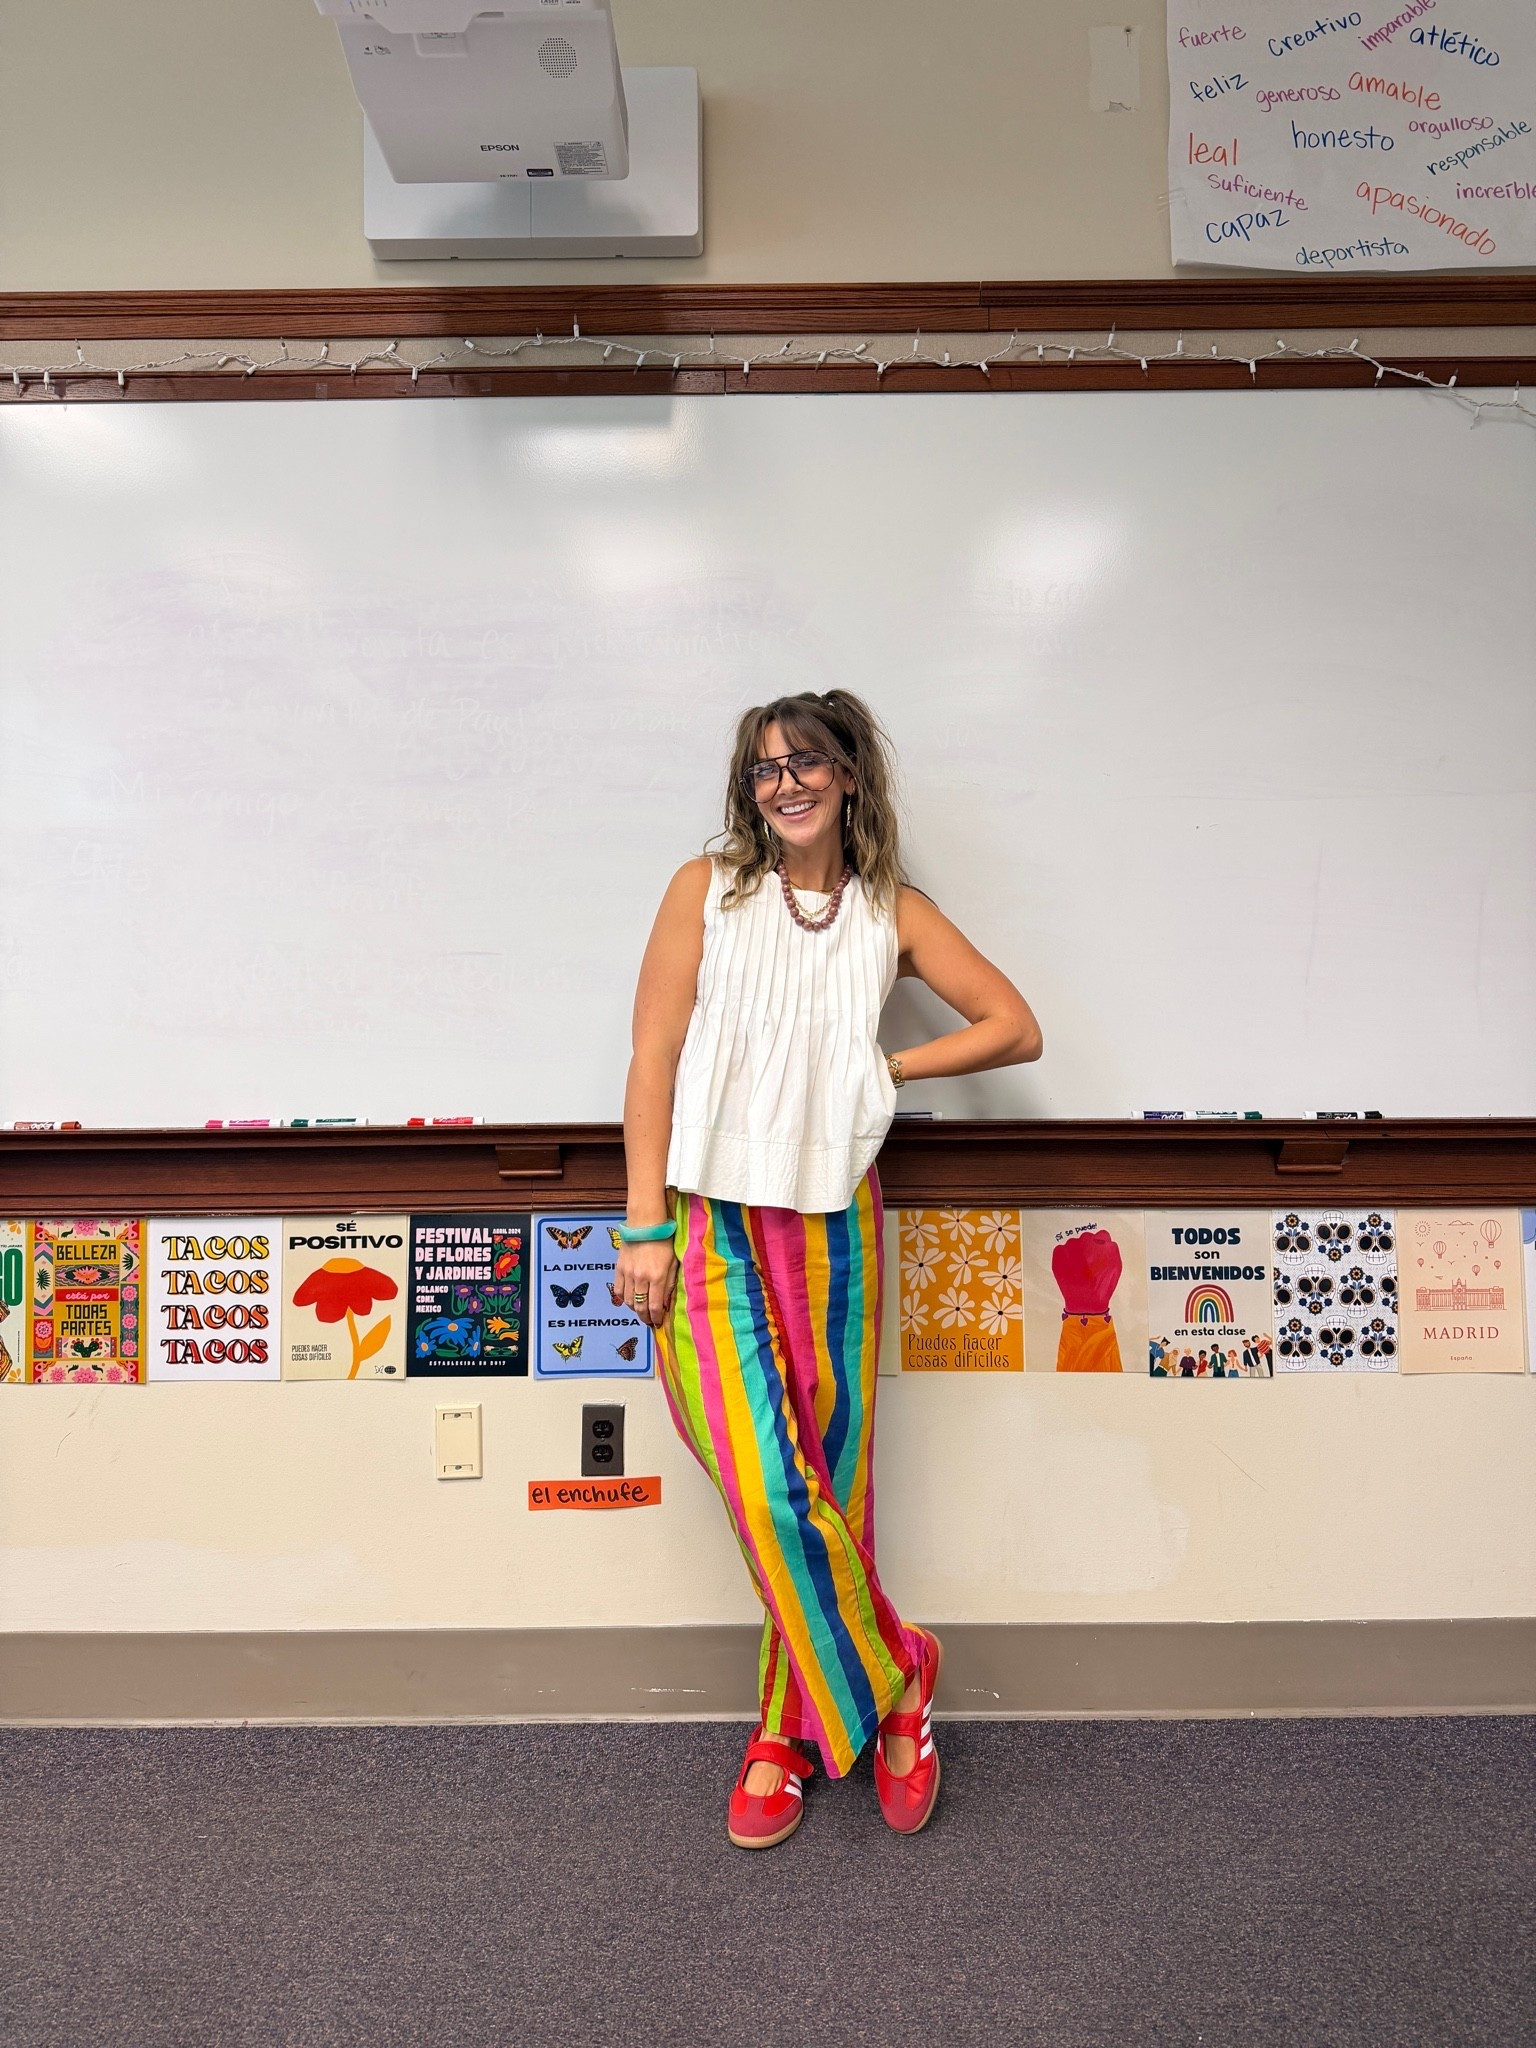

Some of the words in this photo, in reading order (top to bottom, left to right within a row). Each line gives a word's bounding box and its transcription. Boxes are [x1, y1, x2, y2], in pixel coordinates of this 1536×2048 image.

[1358, 0, 1437, 51] imparable
[1178, 24, 1247, 48] fuerte
[1409, 25, 1500, 66] atlético
[1189, 73, 1249, 102] feliz
[1348, 71, 1442, 111] amable
[1255, 85, 1341, 113] generoso
[1291, 120, 1395, 152] honesto
[1408, 116, 1494, 140] orgulloso
[480, 144, 520, 152] EPSON
[1188, 132, 1238, 166] leal
[1426, 119, 1532, 175] responsable
[1356, 181, 1496, 256] apasionado
[1295, 237, 1410, 269] deportista
[335, 1220, 357, 1232] SÉ
[289, 1234, 404, 1250] POSITIVO
[415, 1228, 492, 1244] FESTIVAL
[1171, 1228, 1241, 1245] TODOS
[56, 1245, 117, 1261] BELLEZA
[161, 1236, 269, 1260] TACOS
[415, 1247, 434, 1262] DE
[436, 1247, 492, 1262] FLORES
[1194, 1250, 1220, 1260] son
[415, 1266, 424, 1281] Y
[425, 1266, 492, 1281] JARDINES
[543, 1264, 562, 1272] LA
[564, 1263, 617, 1271] DIVERSI
[1150, 1265, 1266, 1281] BIENVENIDOS
[0, 1248, 23, 1306] O
[161, 1270, 269, 1294] TACOS
[65, 1292, 88, 1300] está
[90, 1292, 110, 1302] por
[416, 1285, 449, 1294] POLANCO
[416, 1295, 435, 1304] CDMX
[66, 1304, 107, 1319] TODAS
[160, 1304, 269, 1330] TACOS
[61, 1320, 111, 1336] PARTES
[547, 1320, 566, 1328] ES
[568, 1318, 641, 1327] HERMOSA
[1191, 1327, 1215, 1336] esta
[1217, 1325, 1246, 1336] clase
[1423, 1326, 1500, 1340] MADRID
[291, 1345, 310, 1353] PUEDES
[311, 1344, 328, 1352] HACER
[908, 1334, 957, 1351] Puedes
[963, 1334, 1003, 1351] hacer
[160, 1338, 269, 1364] TACOS
[291, 1353, 308, 1361] COSAS
[908, 1354, 948, 1368] cosas
[531, 1487, 551, 1504] el
[556, 1482, 649, 1504] enchufe
